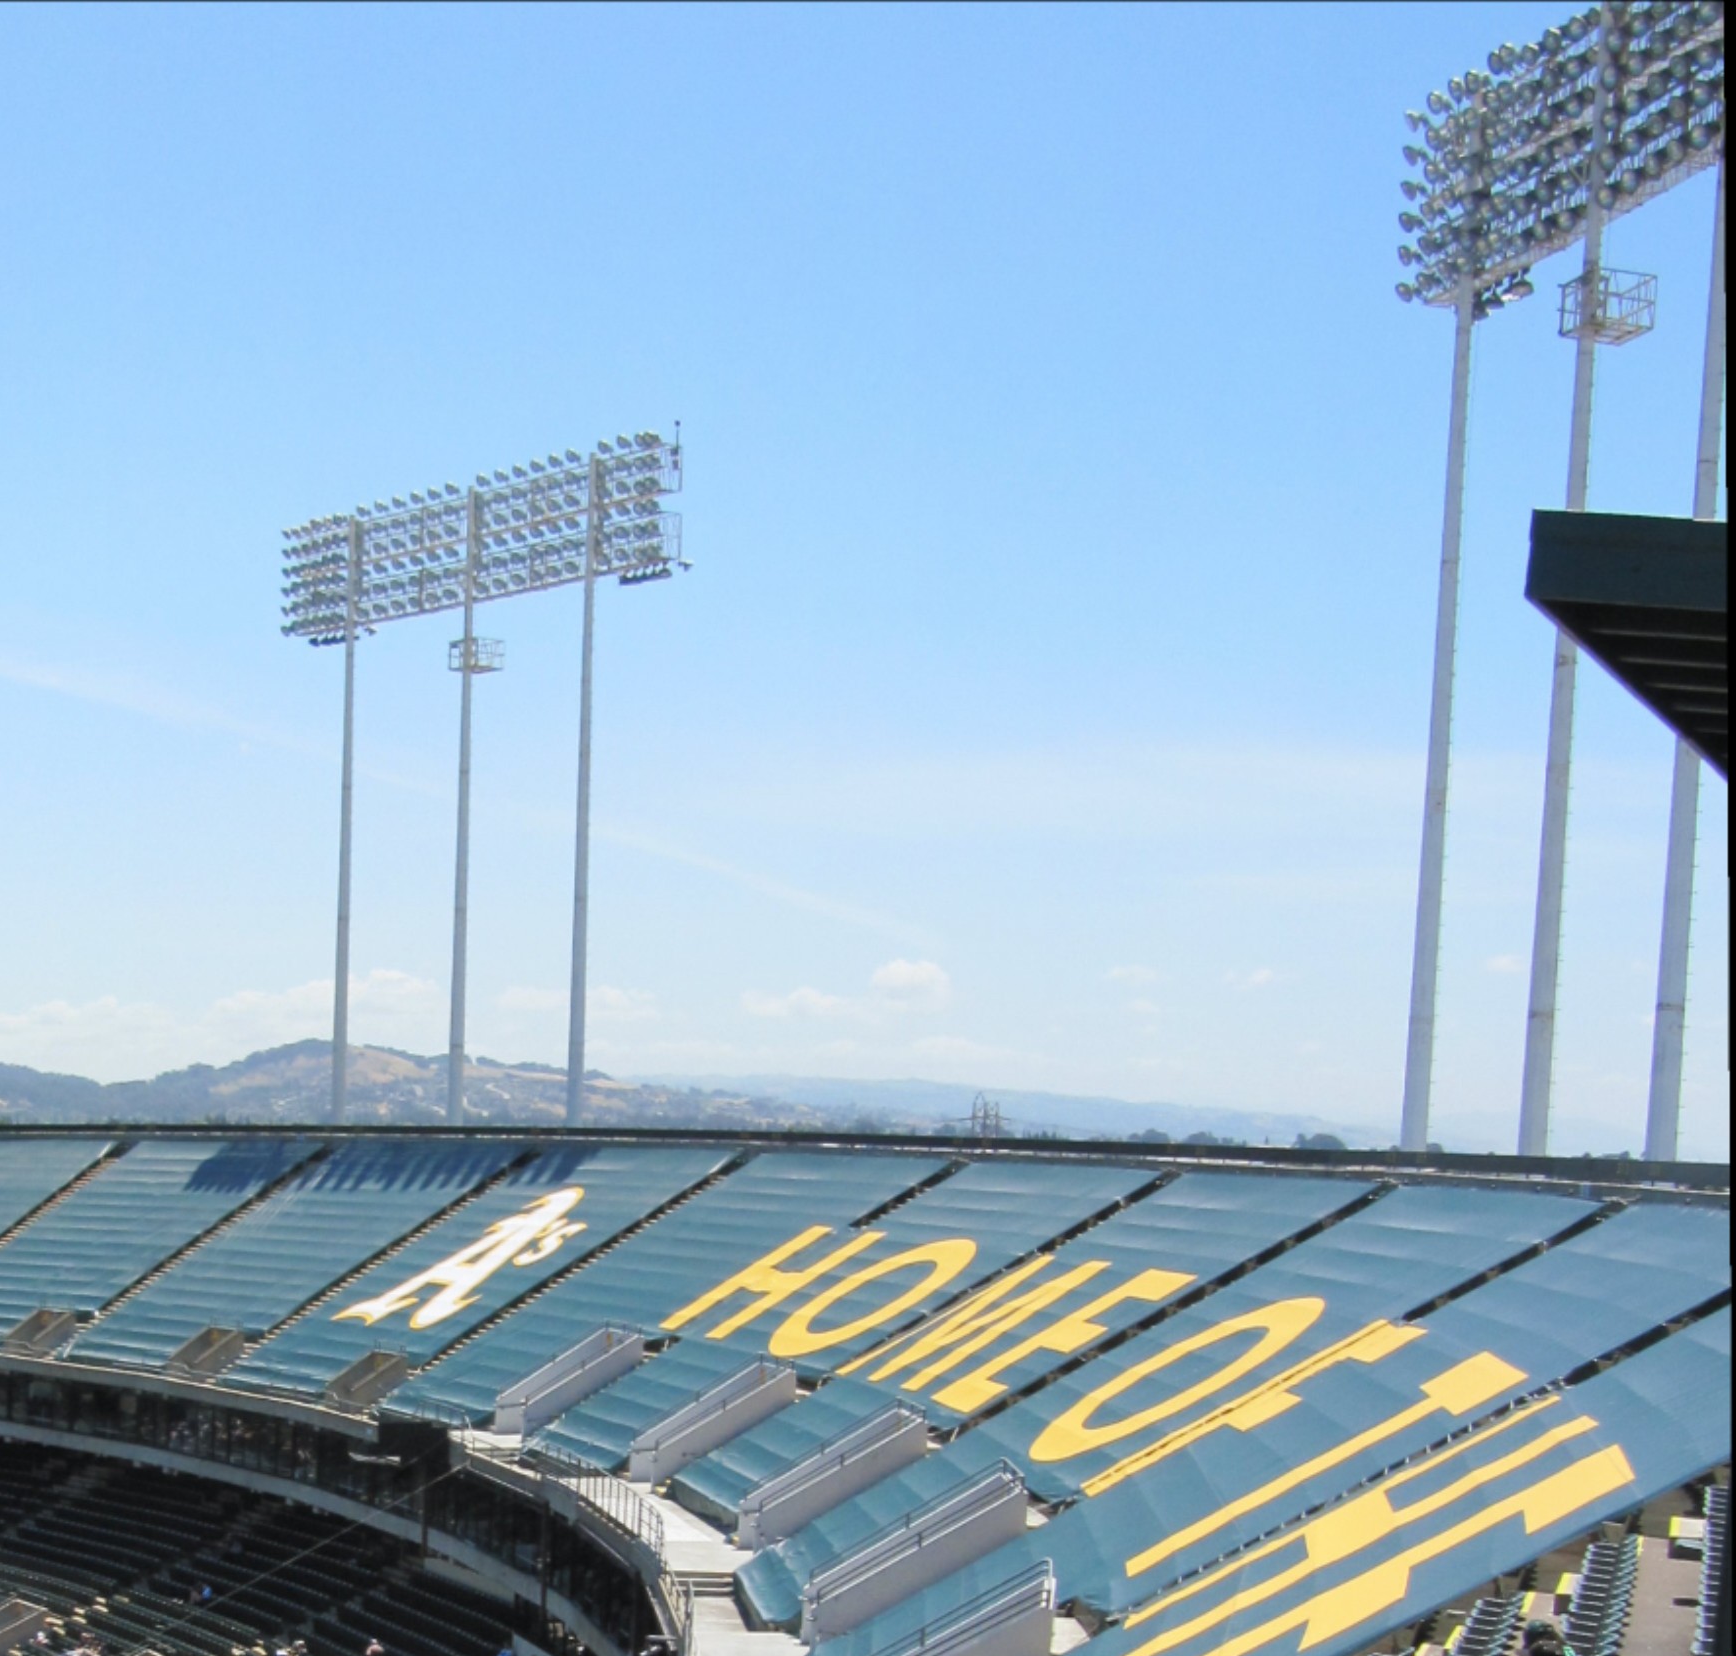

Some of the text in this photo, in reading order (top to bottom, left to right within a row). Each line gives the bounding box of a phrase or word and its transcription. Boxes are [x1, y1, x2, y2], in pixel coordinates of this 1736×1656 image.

[329, 1186, 589, 1330] A's
[661, 1223, 1199, 1413] HOME
[1027, 1296, 1427, 1497] OF
